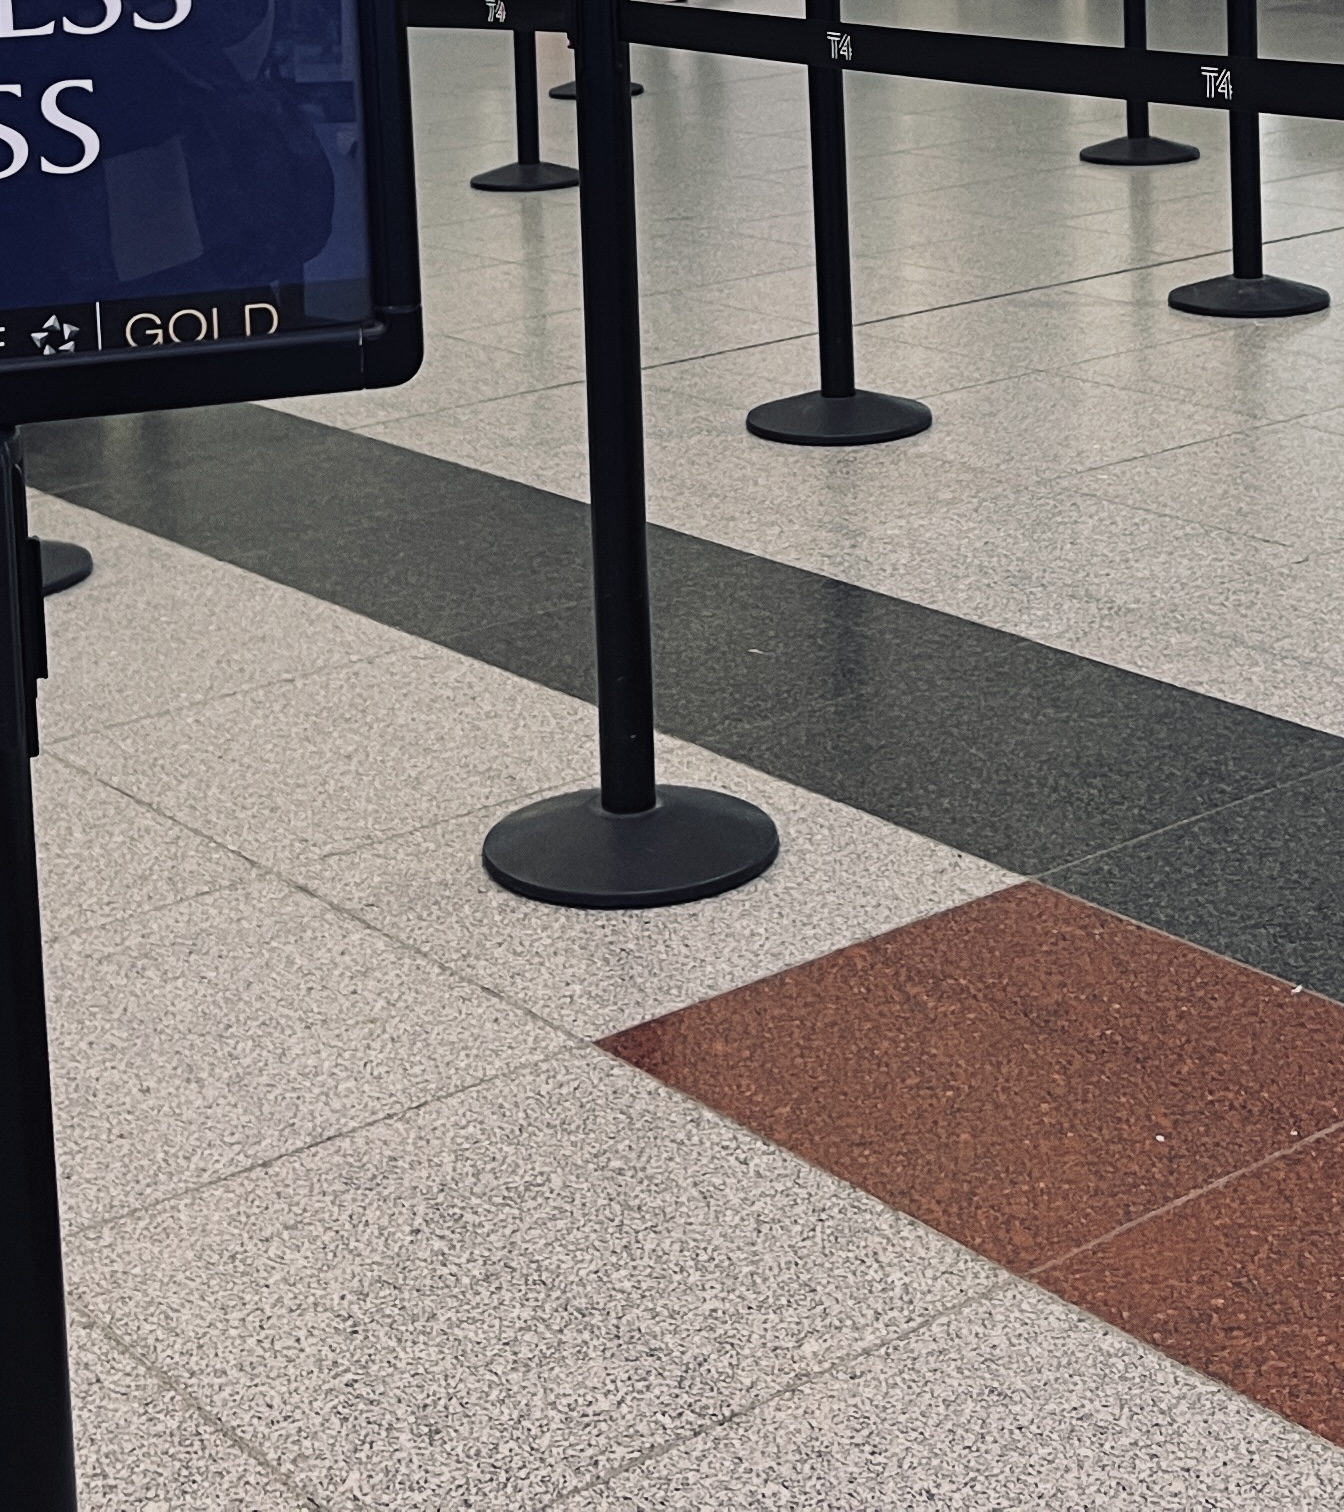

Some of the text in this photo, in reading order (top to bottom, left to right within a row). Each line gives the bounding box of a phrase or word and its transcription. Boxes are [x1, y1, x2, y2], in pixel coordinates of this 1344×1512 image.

[826, 31, 853, 61] T4
[1200, 66, 1233, 101] T4
[125, 302, 280, 350] GOLD
